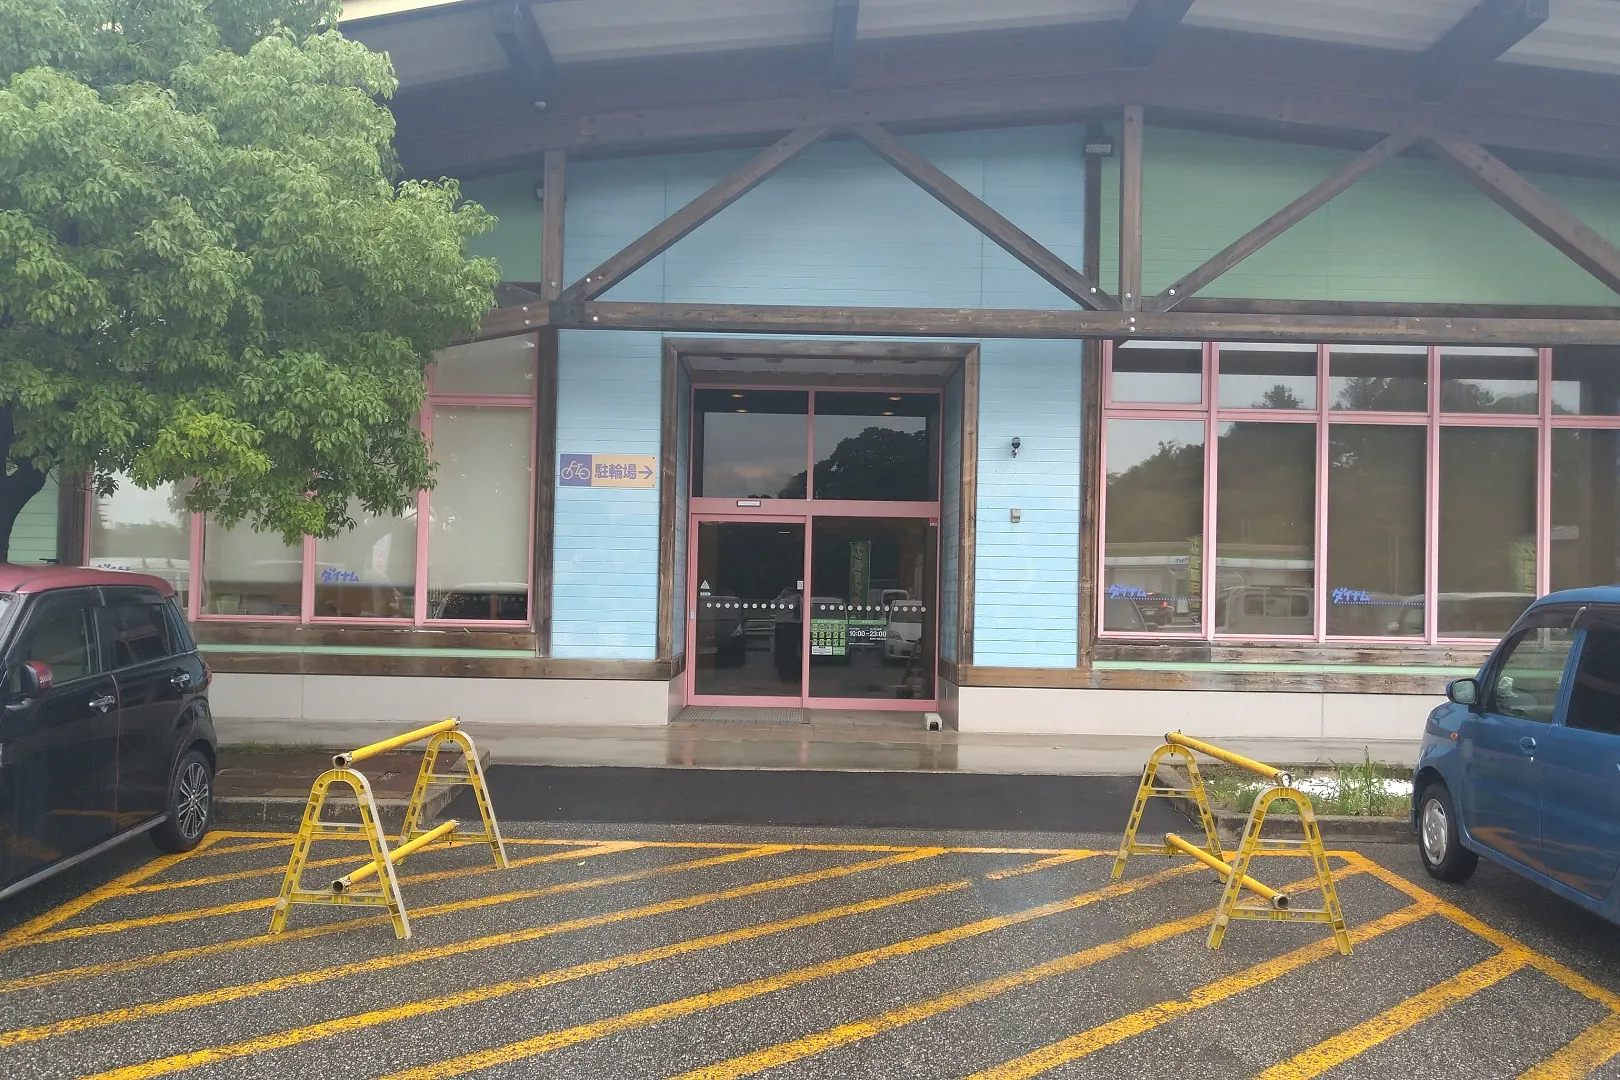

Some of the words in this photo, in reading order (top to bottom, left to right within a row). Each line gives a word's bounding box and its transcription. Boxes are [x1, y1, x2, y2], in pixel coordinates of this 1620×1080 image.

[594, 463, 637, 479] 駐輪場
[320, 567, 360, 585] ダイナム
[1108, 583, 1147, 600] ダイナム
[1331, 587, 1370, 604] ダイナム
